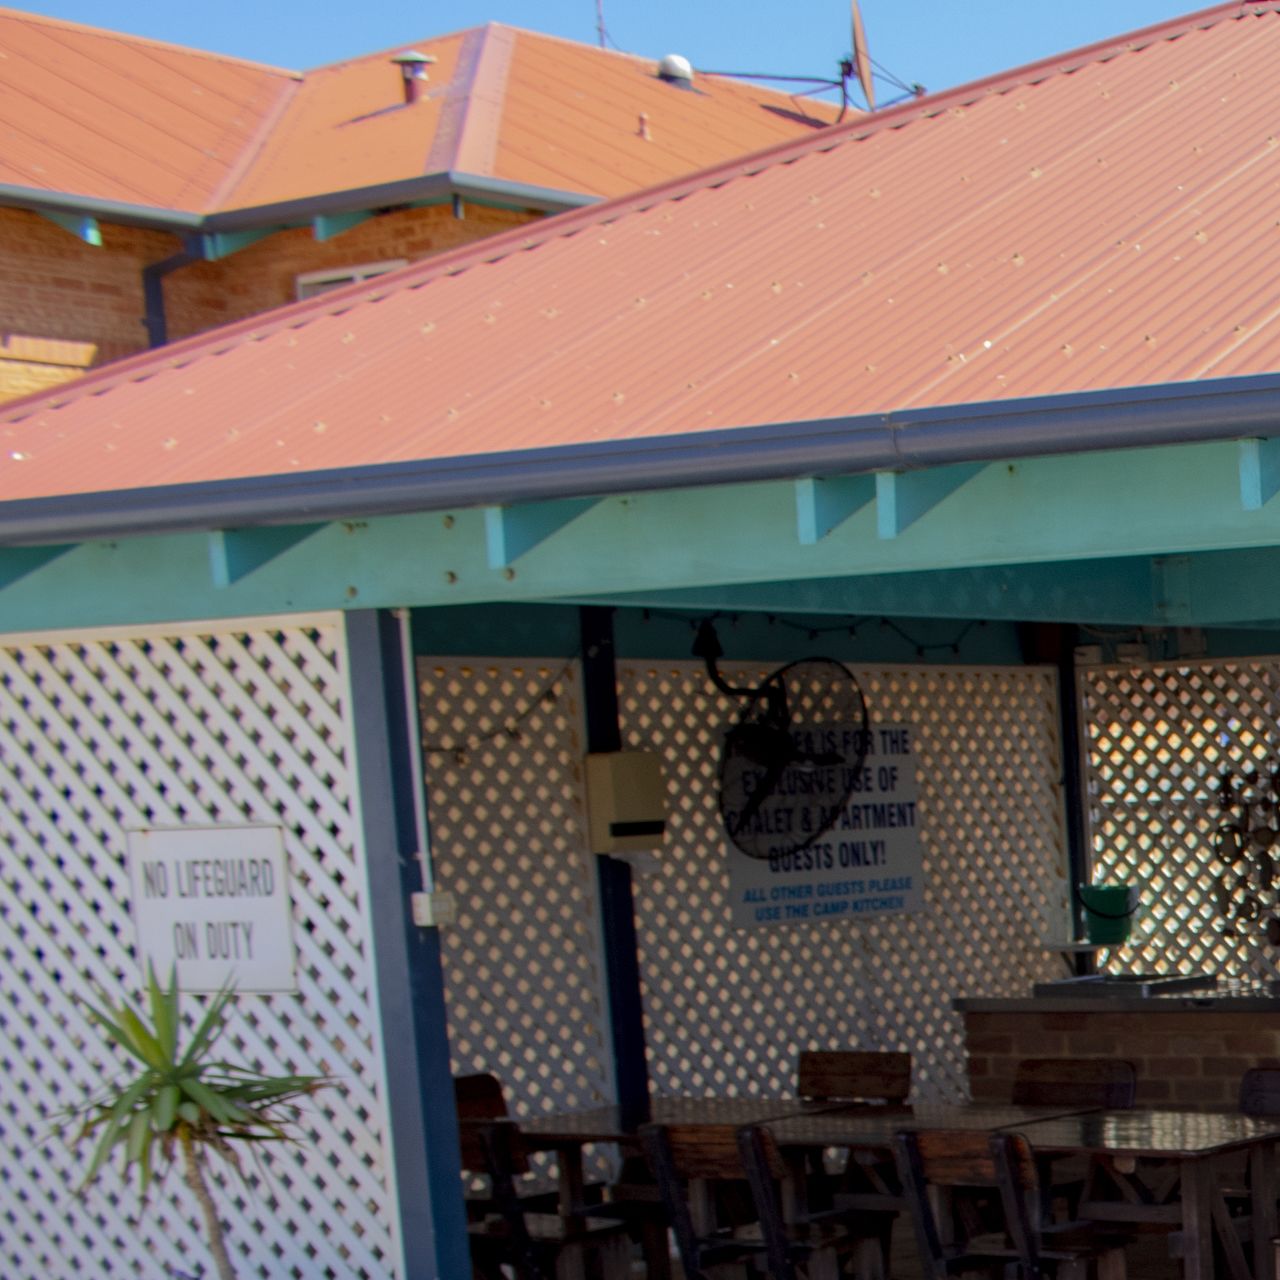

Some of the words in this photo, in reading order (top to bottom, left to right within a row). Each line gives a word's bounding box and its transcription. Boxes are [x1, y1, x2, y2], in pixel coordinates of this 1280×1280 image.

[820, 730, 837, 754] IS
[843, 729, 874, 755] FOR
[880, 729, 909, 755] THE
[742, 767, 835, 797] EXLUSIVE
[842, 766, 873, 793] USE
[879, 766, 898, 792] OF
[801, 807, 812, 832] &
[769, 843, 833, 873] GUESTS
[840, 840, 886, 868] ONLY!
[143, 861, 168, 898] NO
[175, 858, 274, 898] LIFEGUARD
[742, 888, 766, 903] ALL
[770, 884, 812, 900] OTHER
[817, 880, 864, 897] GUESTS
[868, 876, 912, 892] PLEASE
[755, 906, 780, 921] USE
[785, 904, 808, 918] THE
[813, 901, 848, 916] CAMP
[852, 896, 904, 912] KITCHEN
[174, 921, 199, 960] ON
[206, 921, 254, 960] DUTY
